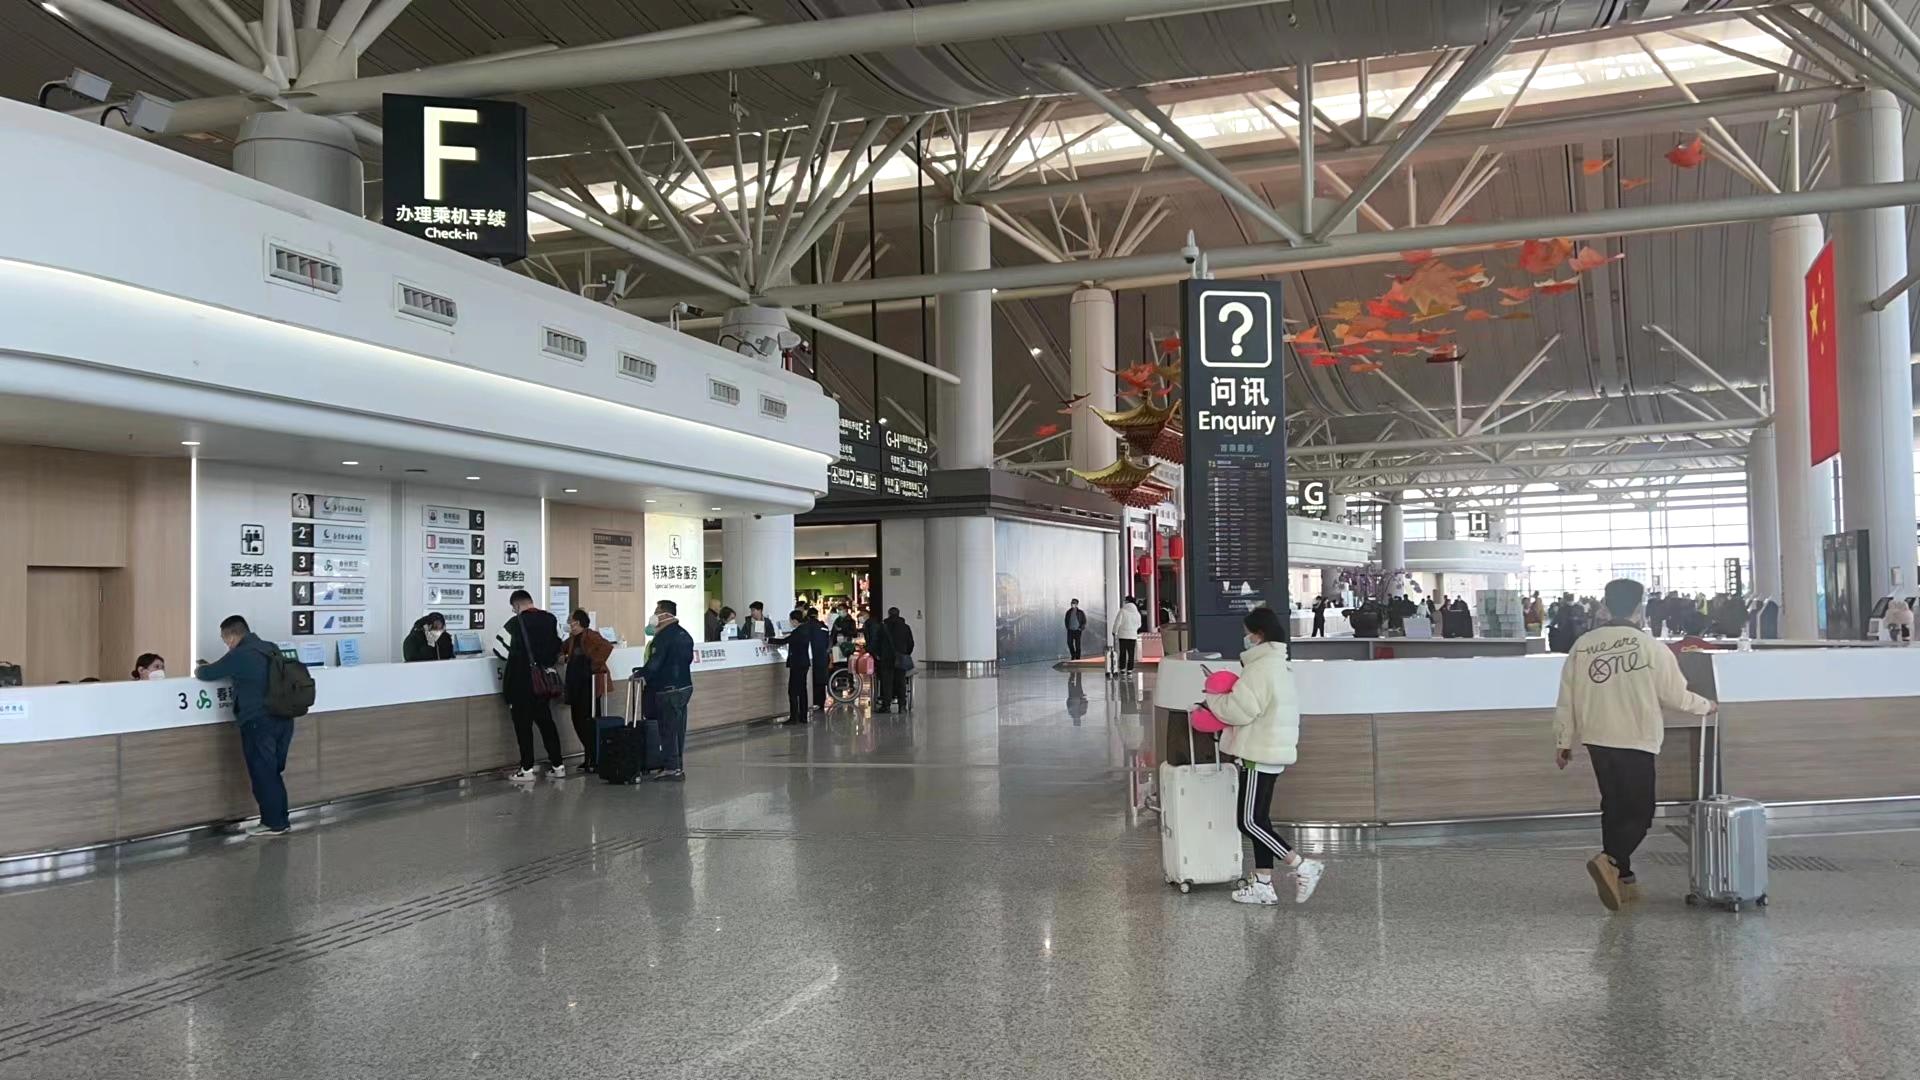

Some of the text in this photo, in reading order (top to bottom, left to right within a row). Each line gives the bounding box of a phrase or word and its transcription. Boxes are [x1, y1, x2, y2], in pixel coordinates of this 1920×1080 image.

[424, 106, 478, 200] F
[396, 205, 506, 227] 办理乘机手续
[424, 227, 478, 240] Check-in
[1211, 377, 1270, 406] 问讯
[1198, 411, 1276, 435] Enquiry
[886, 430, 899, 449] G-H
[850, 470, 855, 486] 2
[1304, 482, 1324, 505] G
[299, 498, 305, 510] 1
[475, 513, 482, 524] 6
[1471, 513, 1486, 530] H
[298, 526, 306, 539] 2
[476, 537, 482, 548] 7
[298, 555, 306, 568] 3
[475, 562, 482, 573] 8
[230, 562, 274, 577] 服务柜台
[497, 570, 525, 582] 服务柜台
[652, 564, 698, 580] 特殊旅客服务
[298, 585, 306, 597] 4
[475, 587, 482, 598] 9
[298, 614, 306, 627] 5
[474, 611, 484, 623] 10
[178, 692, 188, 710] 3
